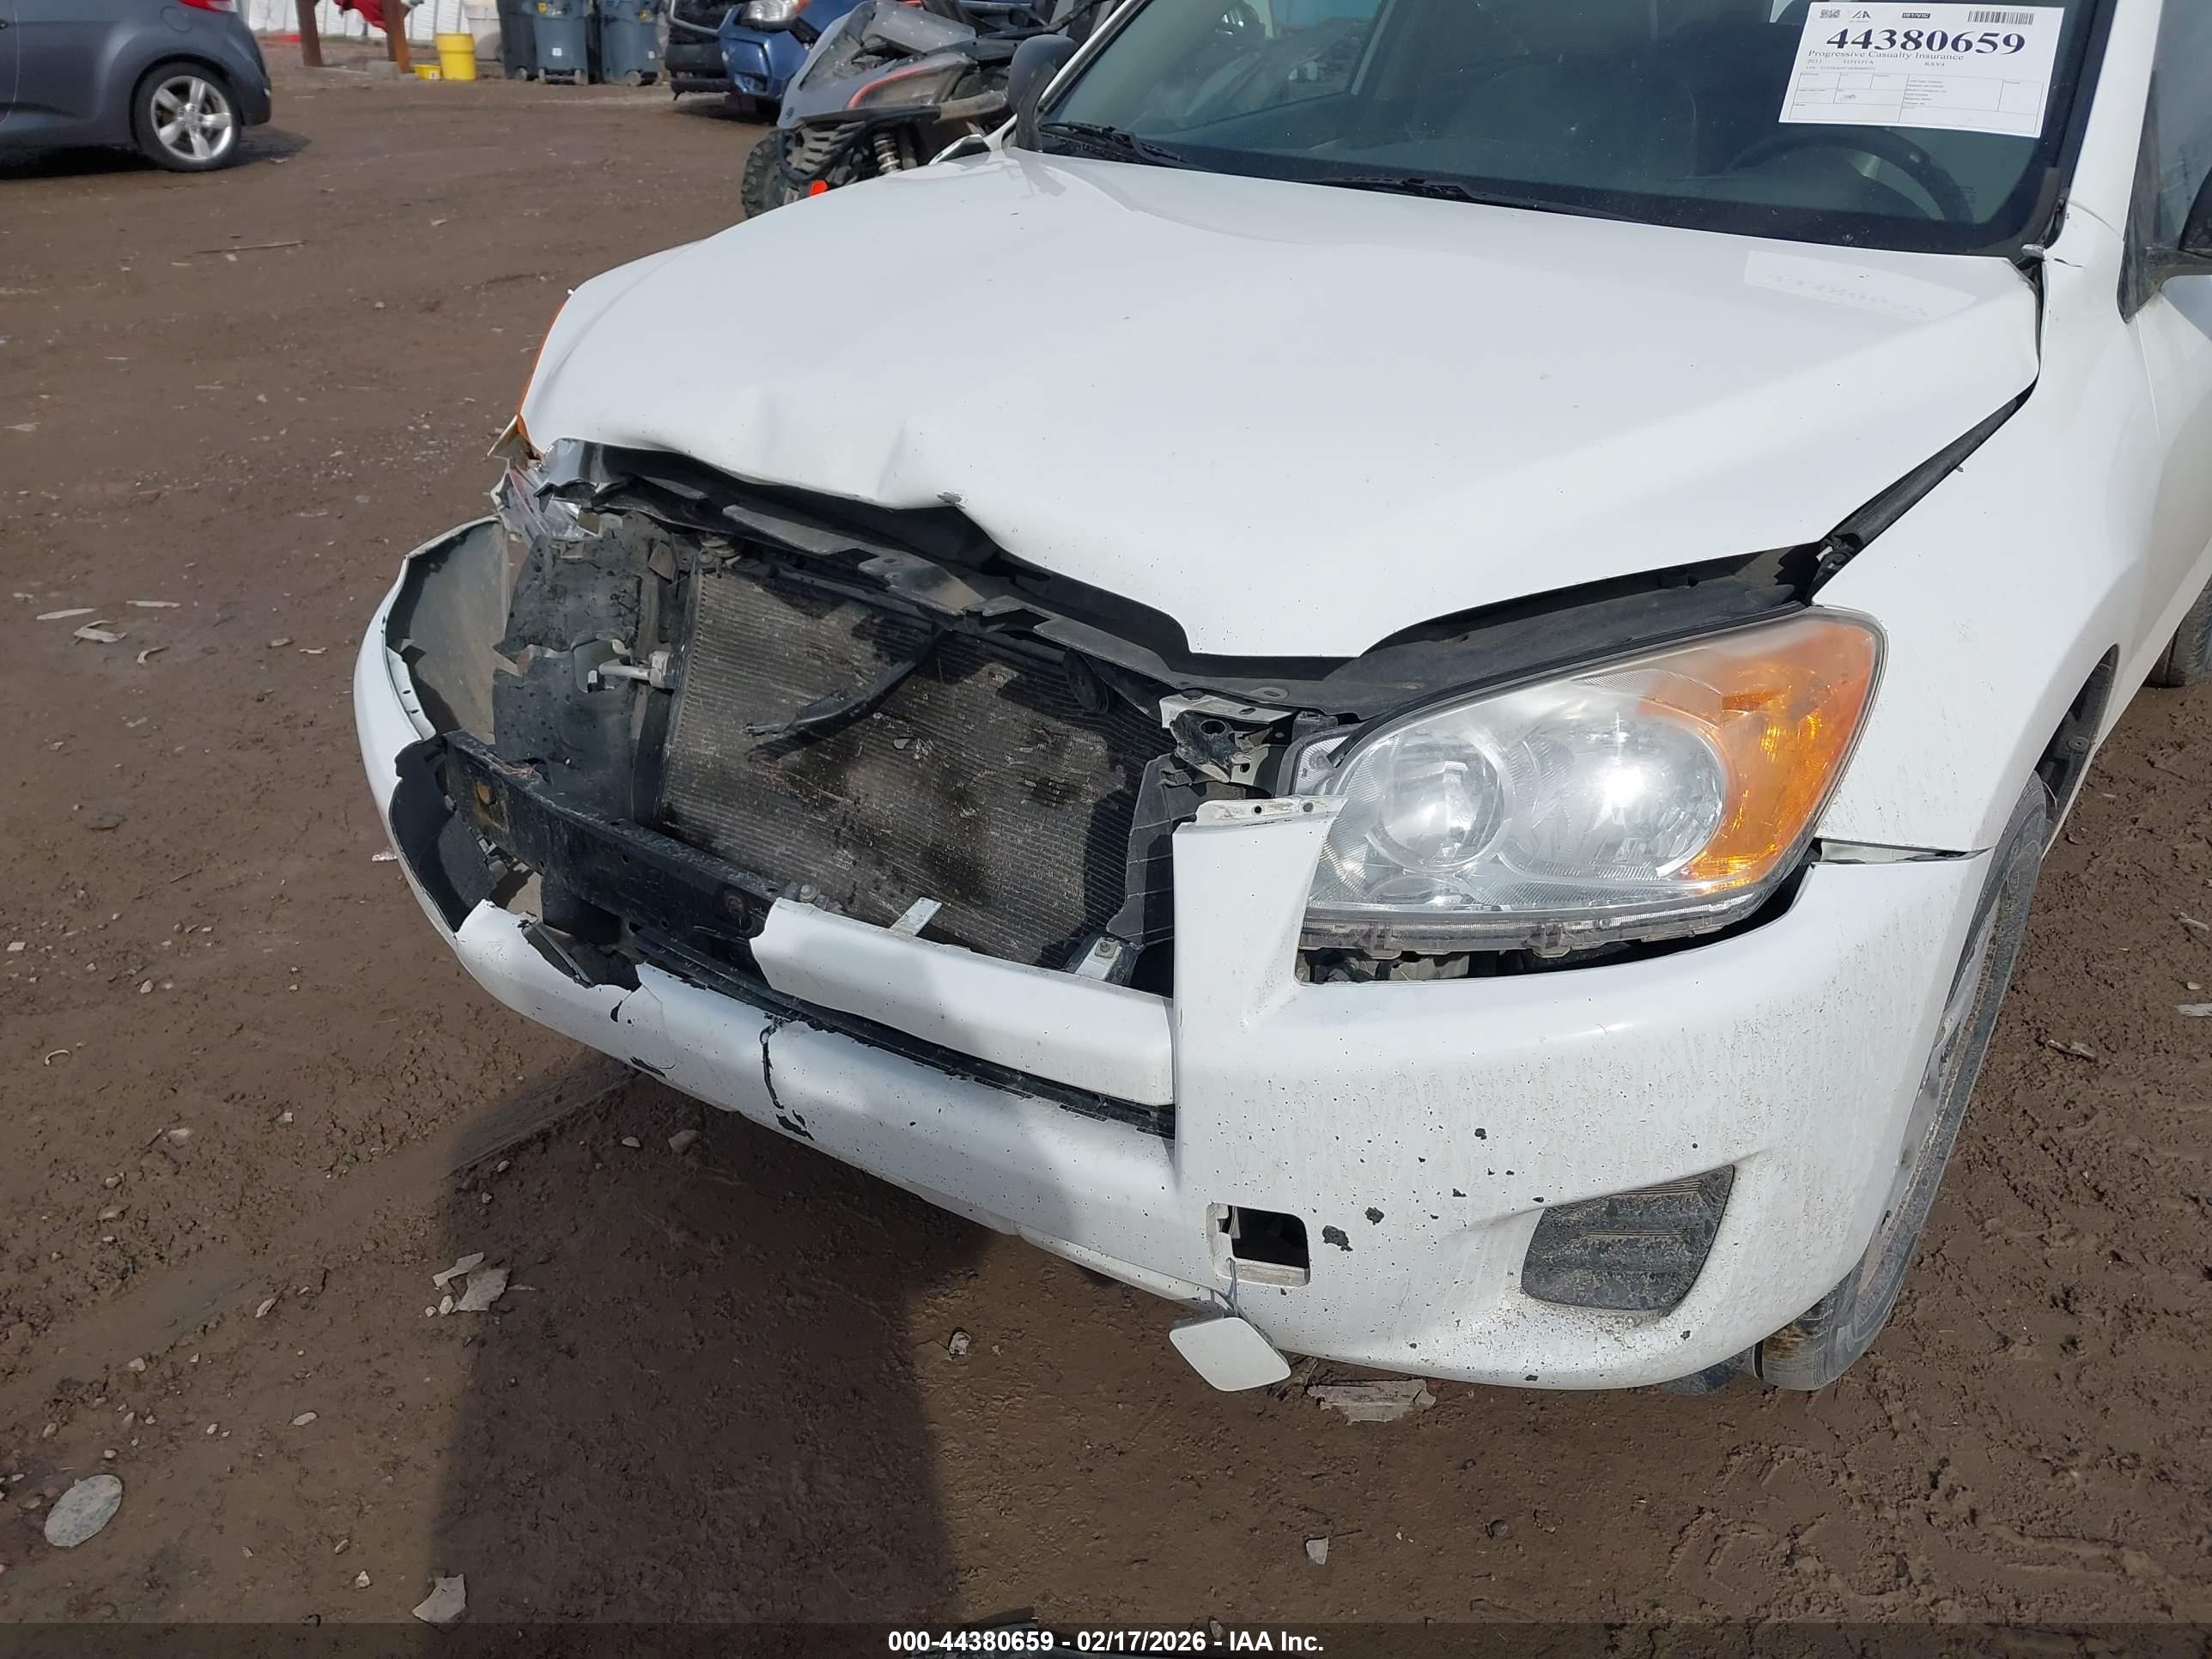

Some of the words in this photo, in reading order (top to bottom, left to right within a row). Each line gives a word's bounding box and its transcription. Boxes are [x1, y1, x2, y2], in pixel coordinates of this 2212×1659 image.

[1826, 27, 2027, 55] 44380659
[1808, 50, 1866, 58] Progressive
[1869, 51, 1912, 60] Casualty
[1916, 52, 1965, 61] Insurance
